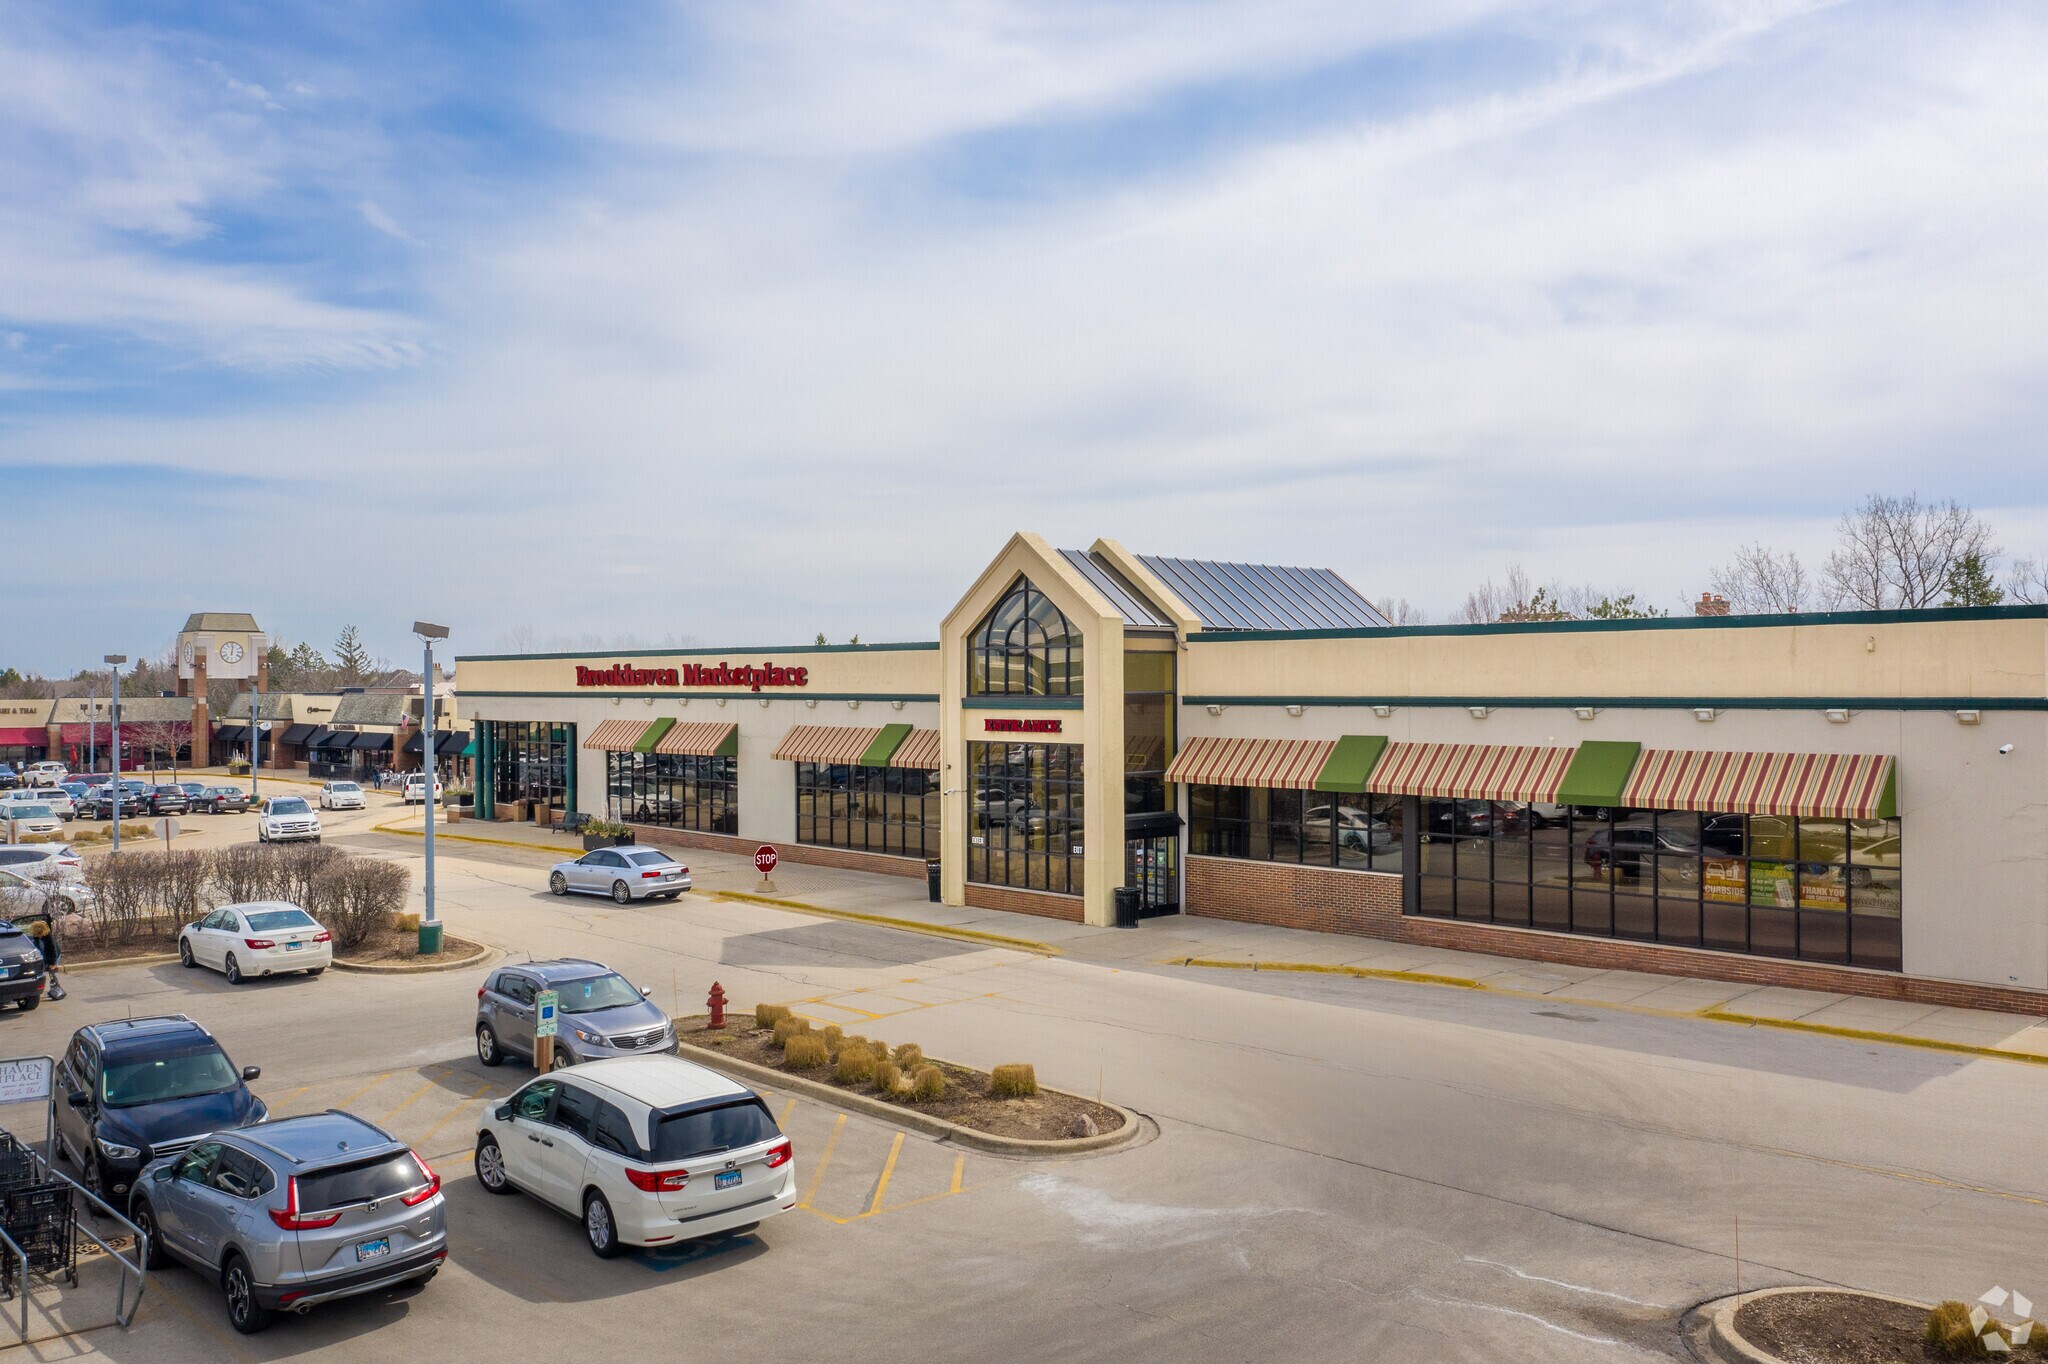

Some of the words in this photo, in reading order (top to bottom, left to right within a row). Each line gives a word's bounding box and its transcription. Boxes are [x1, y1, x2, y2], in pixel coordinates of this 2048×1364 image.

[576, 664, 679, 686] Brookhaven
[682, 662, 808, 692] Marketplace
[984, 719, 1062, 733] ENTRANCE
[1073, 845, 1083, 854] EXIT
[756, 853, 776, 865] STOP
[1704, 884, 1745, 896] CURBSIDE
[1802, 885, 1827, 896] THANK
[1828, 888, 1845, 897] YOU
[0, 1063, 42, 1076] HAVEN
